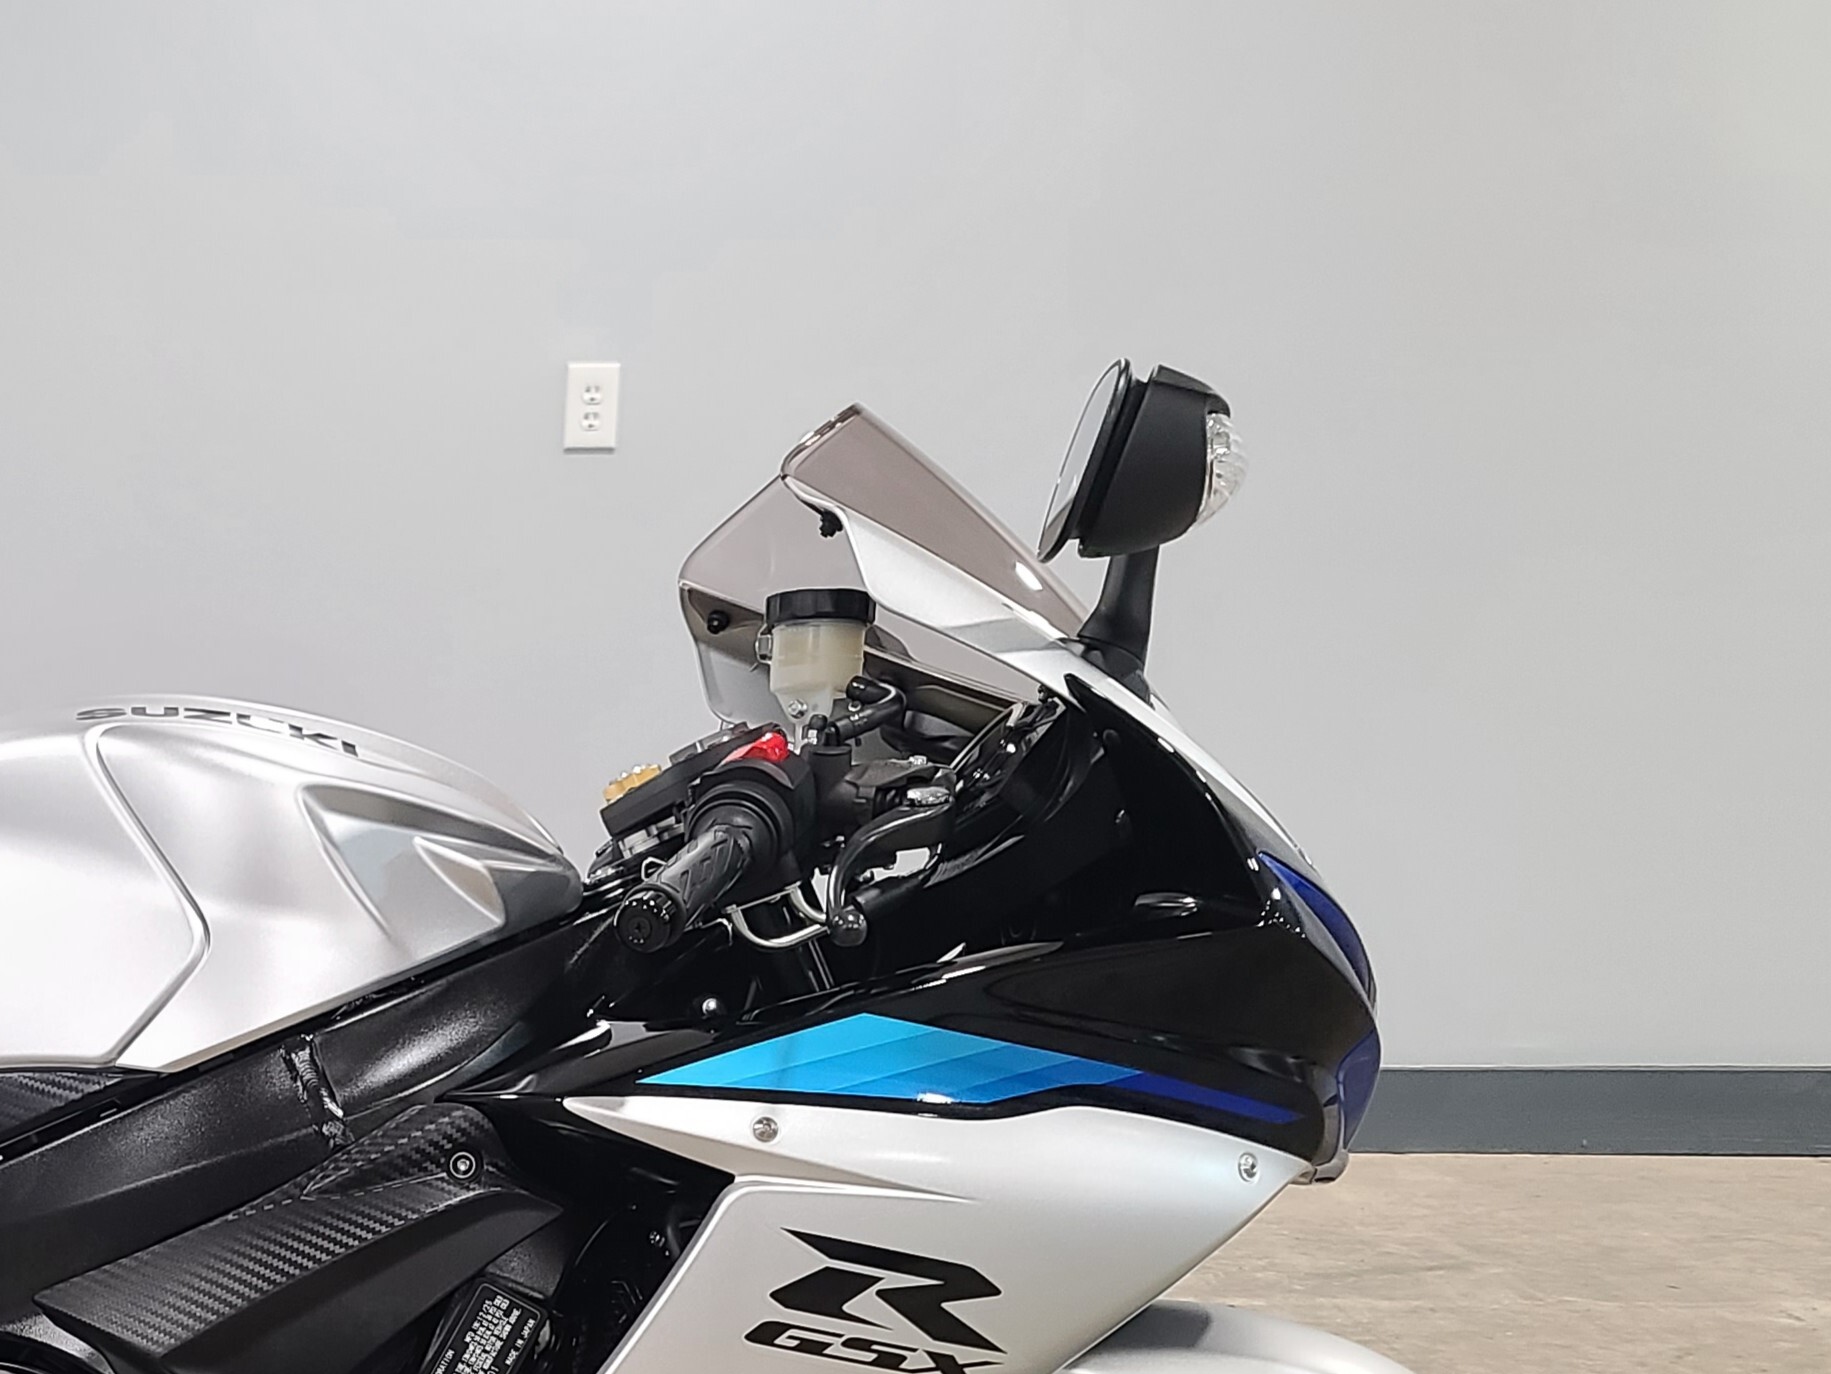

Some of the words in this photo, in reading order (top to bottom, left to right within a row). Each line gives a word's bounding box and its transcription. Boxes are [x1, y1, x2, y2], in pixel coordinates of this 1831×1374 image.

[76, 706, 358, 757] SUZUKI
[769, 1227, 1007, 1354] R
[520, 1318, 535, 1338] JAPAN
